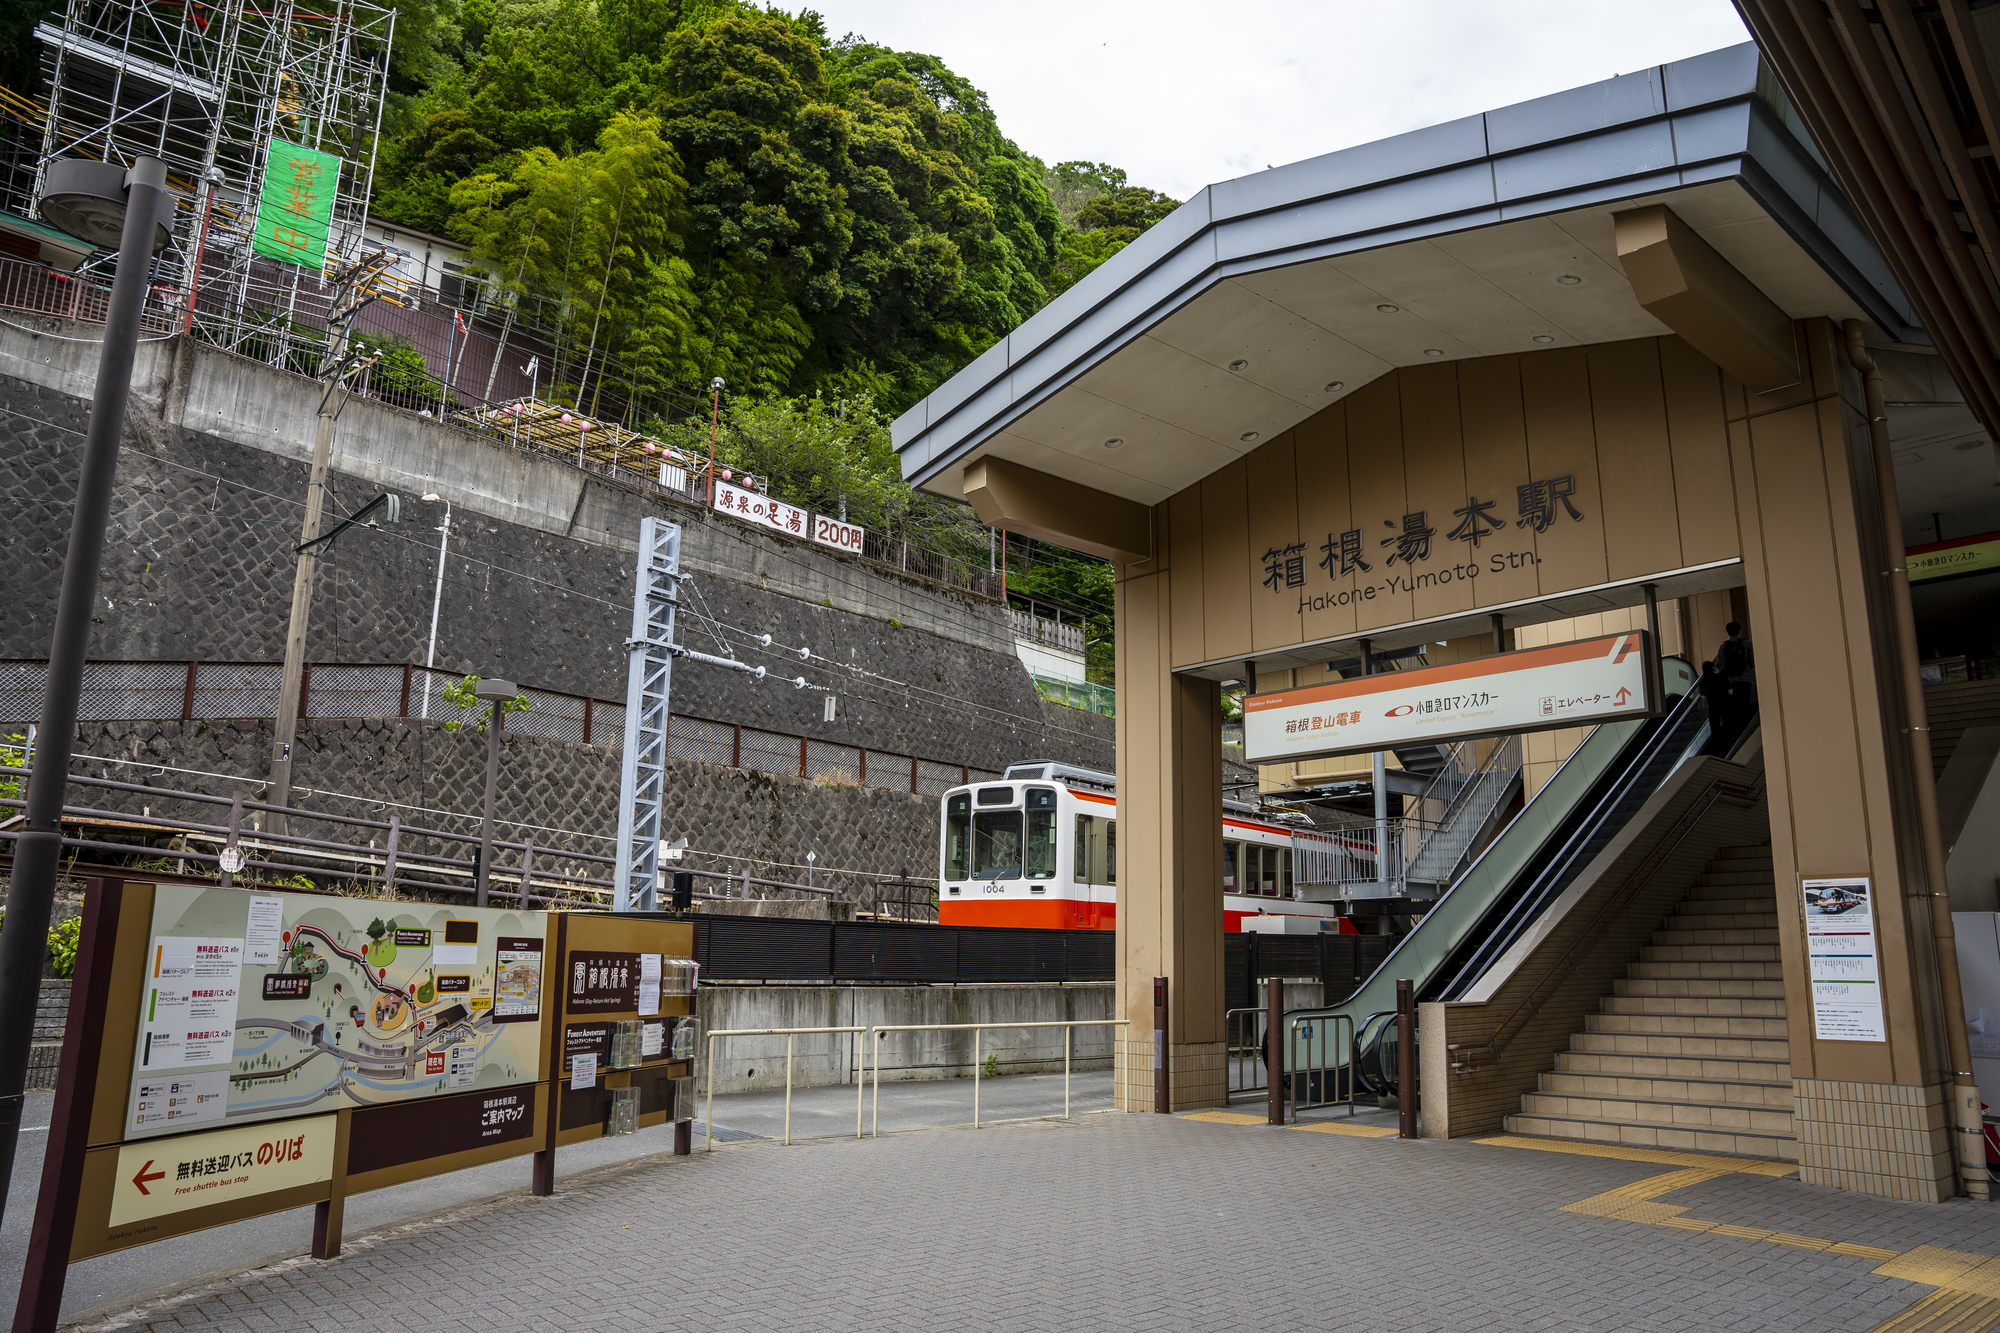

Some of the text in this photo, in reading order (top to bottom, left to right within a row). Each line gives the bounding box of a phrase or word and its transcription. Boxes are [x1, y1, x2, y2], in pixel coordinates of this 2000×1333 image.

[274, 158, 321, 255] 営業中
[719, 489, 802, 533] 源泉の足湯
[818, 519, 862, 550] 200円
[1261, 475, 1583, 592] 箱根湯本駅
[1920, 551, 1982, 567] 小田急ロマンスカー
[1297, 551, 1542, 614] Hakone-Yumoto Stn.
[1248, 699, 1265, 707] Odakyu
[1415, 691, 1499, 715] 小田急ロマンスカー
[1558, 693, 1610, 708] エレベーター
[1285, 710, 1362, 734] 箱根登山電車
[1416, 716, 1436, 725] Limited
[1436, 713, 1457, 723] Express
[1285, 730, 1340, 742] Hakone Tozan Railway
[983, 885, 1005, 894] 1004
[481, 1104, 525, 1126] ご案内マップ
[174, 1175, 249, 1195] Free shuttle bus stop
[107, 1225, 158, 1241] Odakyu Hakone
